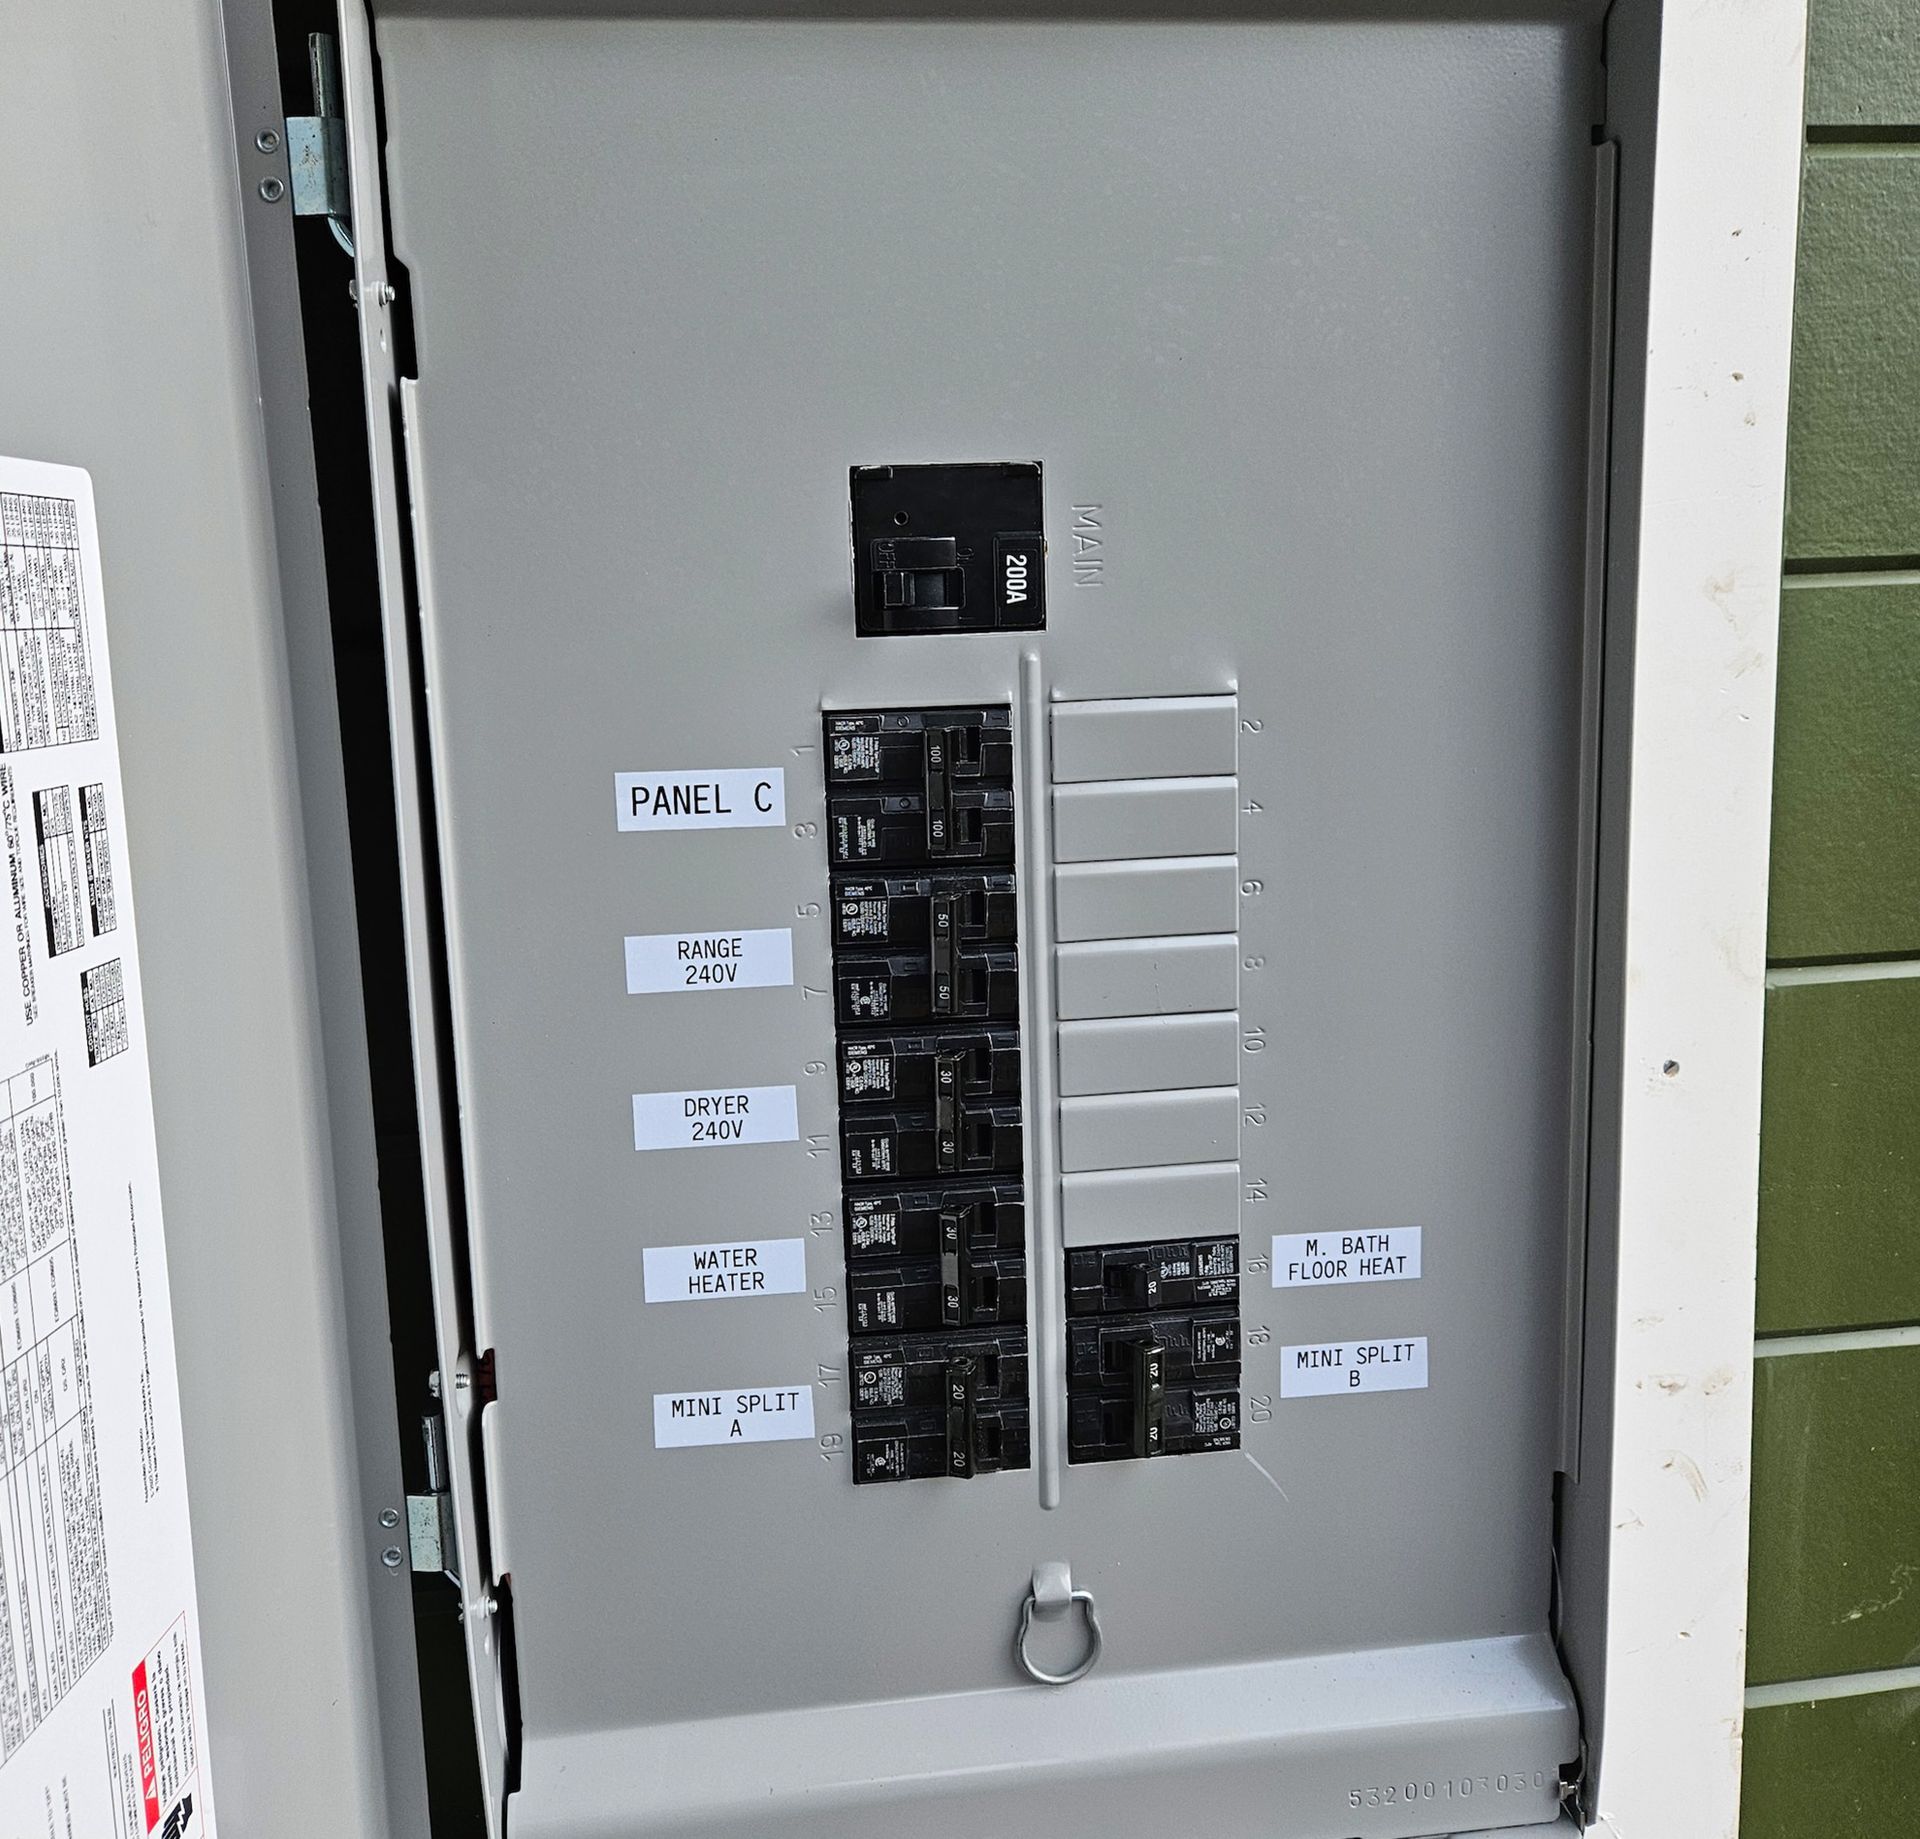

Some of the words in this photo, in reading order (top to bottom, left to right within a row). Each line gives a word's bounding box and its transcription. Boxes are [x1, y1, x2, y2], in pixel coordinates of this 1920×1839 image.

[1072, 504, 1103, 588] MAIN
[1006, 555, 1027, 604] 200A
[1240, 719, 1264, 734] 2
[790, 745, 814, 757] 1
[931, 745, 941, 763] 100
[0, 762, 8, 796] WIRE
[632, 784, 731, 816] PANEL
[755, 782, 772, 812] C
[1242, 800, 1263, 814] 4
[793, 822, 817, 839] 3
[932, 819, 944, 838] 100
[9, 851, 21, 923] ALUMINUM
[1241, 879, 1264, 896] 6
[797, 903, 820, 918] 5
[938, 914, 948, 928] 50
[16, 921, 23, 945] OR
[678, 938, 743, 960] RANGE
[18, 943, 29, 1001] COPPER
[686, 964, 737, 984] 240V
[803, 986, 828, 1000] 7
[938, 986, 950, 999] 50
[24, 997, 32, 1029] USE
[1244, 1026, 1265, 1053] 10
[804, 1061, 827, 1076] 9
[941, 1070, 952, 1083] 30
[685, 1095, 749, 1117] DRYER
[1244, 1103, 1266, 1127] 12
[692, 1120, 743, 1141] 240V
[807, 1134, 830, 1158] 11
[943, 1141, 954, 1154] 30
[1246, 1177, 1268, 1202] 14
[811, 1211, 833, 1237] 13
[946, 1227, 957, 1240] 30
[1307, 1240, 1326, 1256] M.
[1343, 1235, 1389, 1254] BATH
[694, 1248, 757, 1269] WATER
[1247, 1253, 1268, 1275] 16
[1290, 1260, 1347, 1280] FLOOR
[1360, 1256, 1406, 1276] HEAT
[689, 1272, 764, 1293] HEATER
[1149, 1281, 1157, 1294] 20
[814, 1287, 837, 1312] 15
[947, 1295, 958, 1308] 30
[1248, 1324, 1270, 1347] 18
[1298, 1349, 1343, 1368] MINI
[1357, 1344, 1414, 1364] SPLIT
[819, 1364, 840, 1390] 17
[1350, 1371, 1360, 1387] B
[953, 1386, 964, 1400] 20
[672, 1397, 721, 1418] MINI
[737, 1393, 799, 1413] SPLIT
[1250, 1396, 1272, 1424] 20
[731, 1419, 742, 1437] A
[821, 1434, 844, 1461] 19
[953, 1453, 965, 1467] 20
[136, 1690, 153, 1779] PELIGRO
